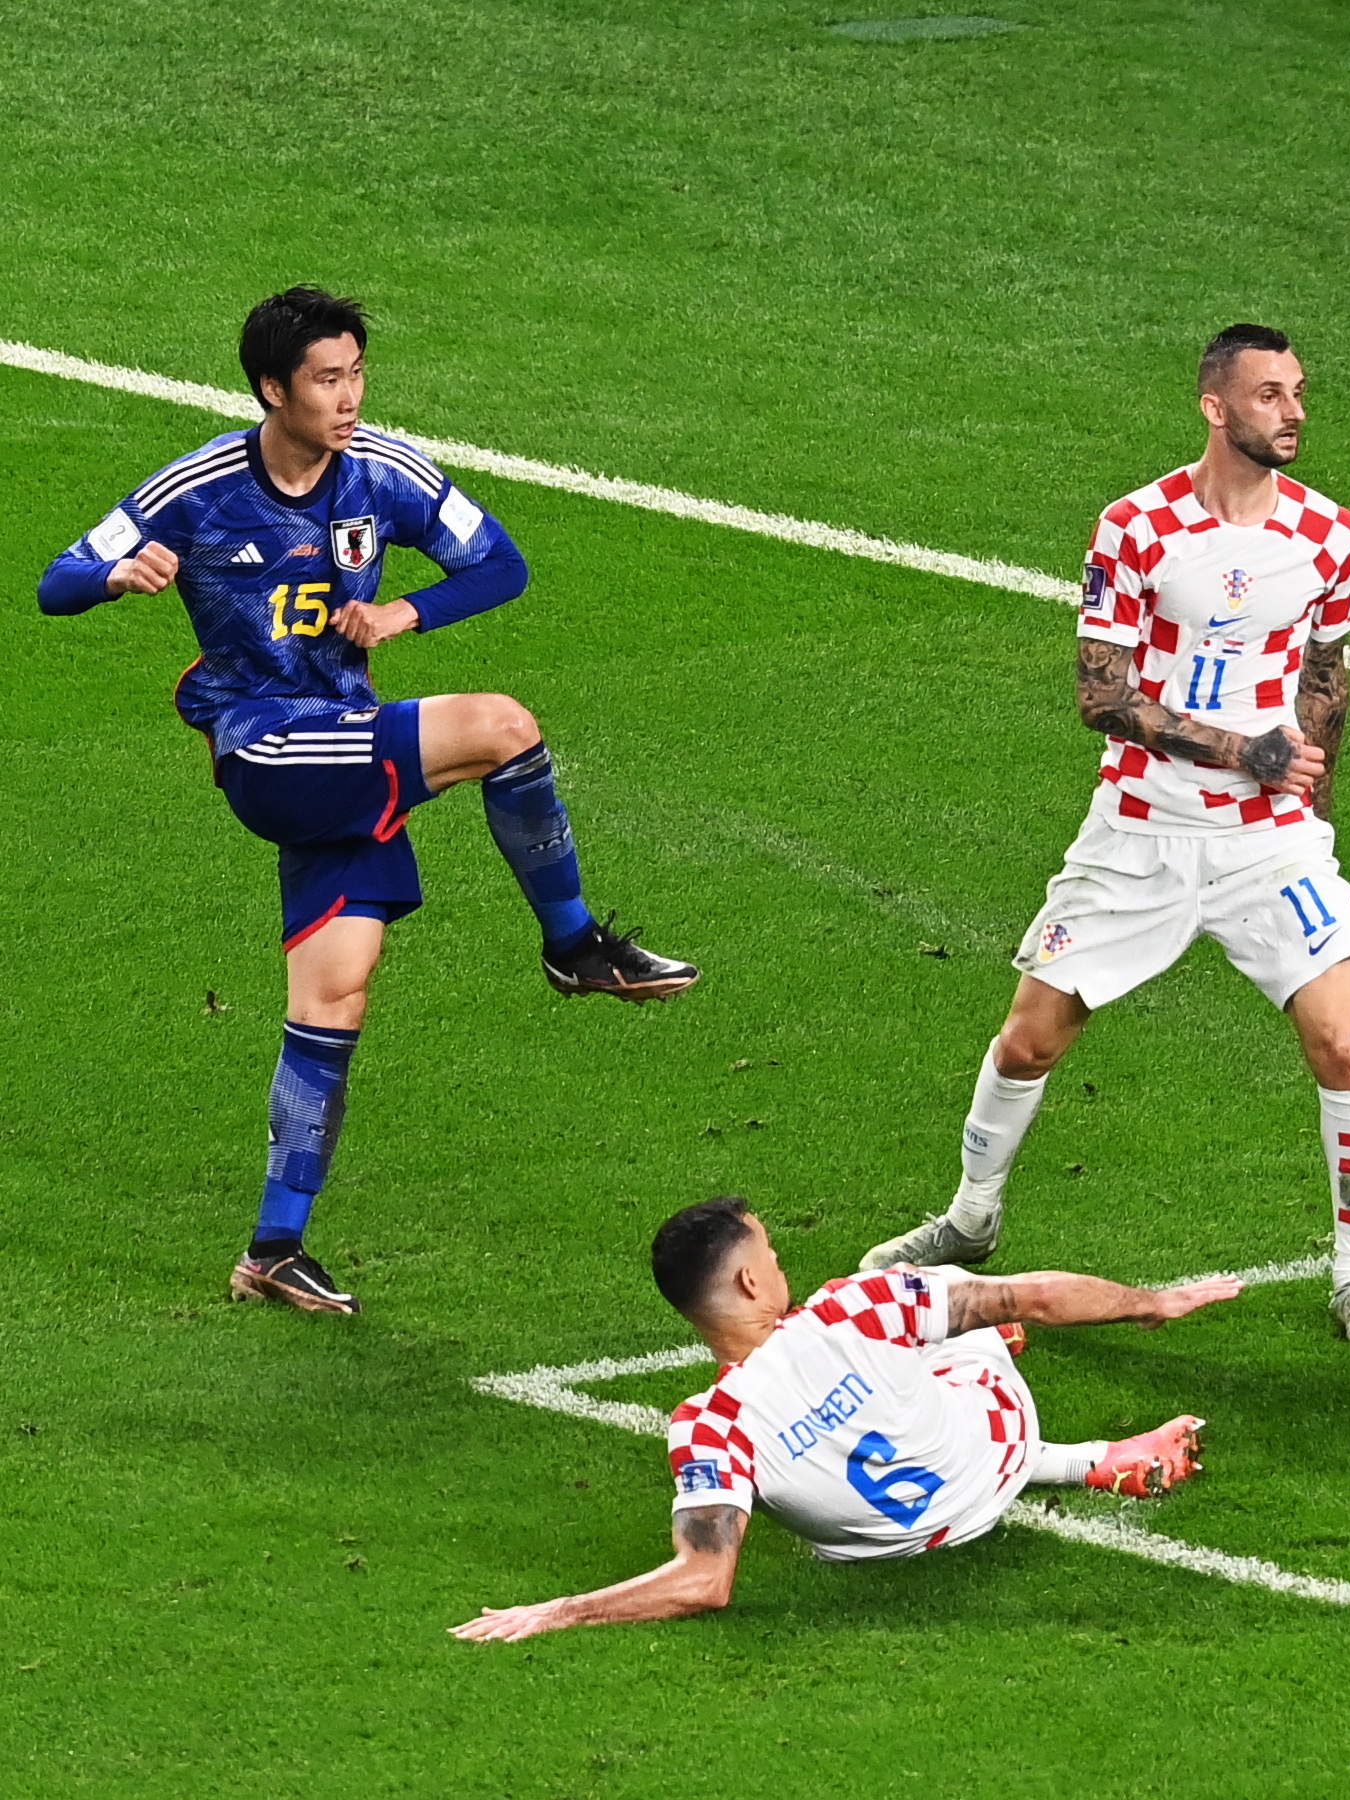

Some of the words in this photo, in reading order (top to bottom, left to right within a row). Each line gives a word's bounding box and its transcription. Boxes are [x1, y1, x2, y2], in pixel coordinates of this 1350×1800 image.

[268, 582, 332, 641] 15
[1184, 655, 1226, 710] 11
[1280, 877, 1336, 938] 11
[778, 1373, 873, 1461] LOVREN
[847, 1430, 945, 1530] 6
